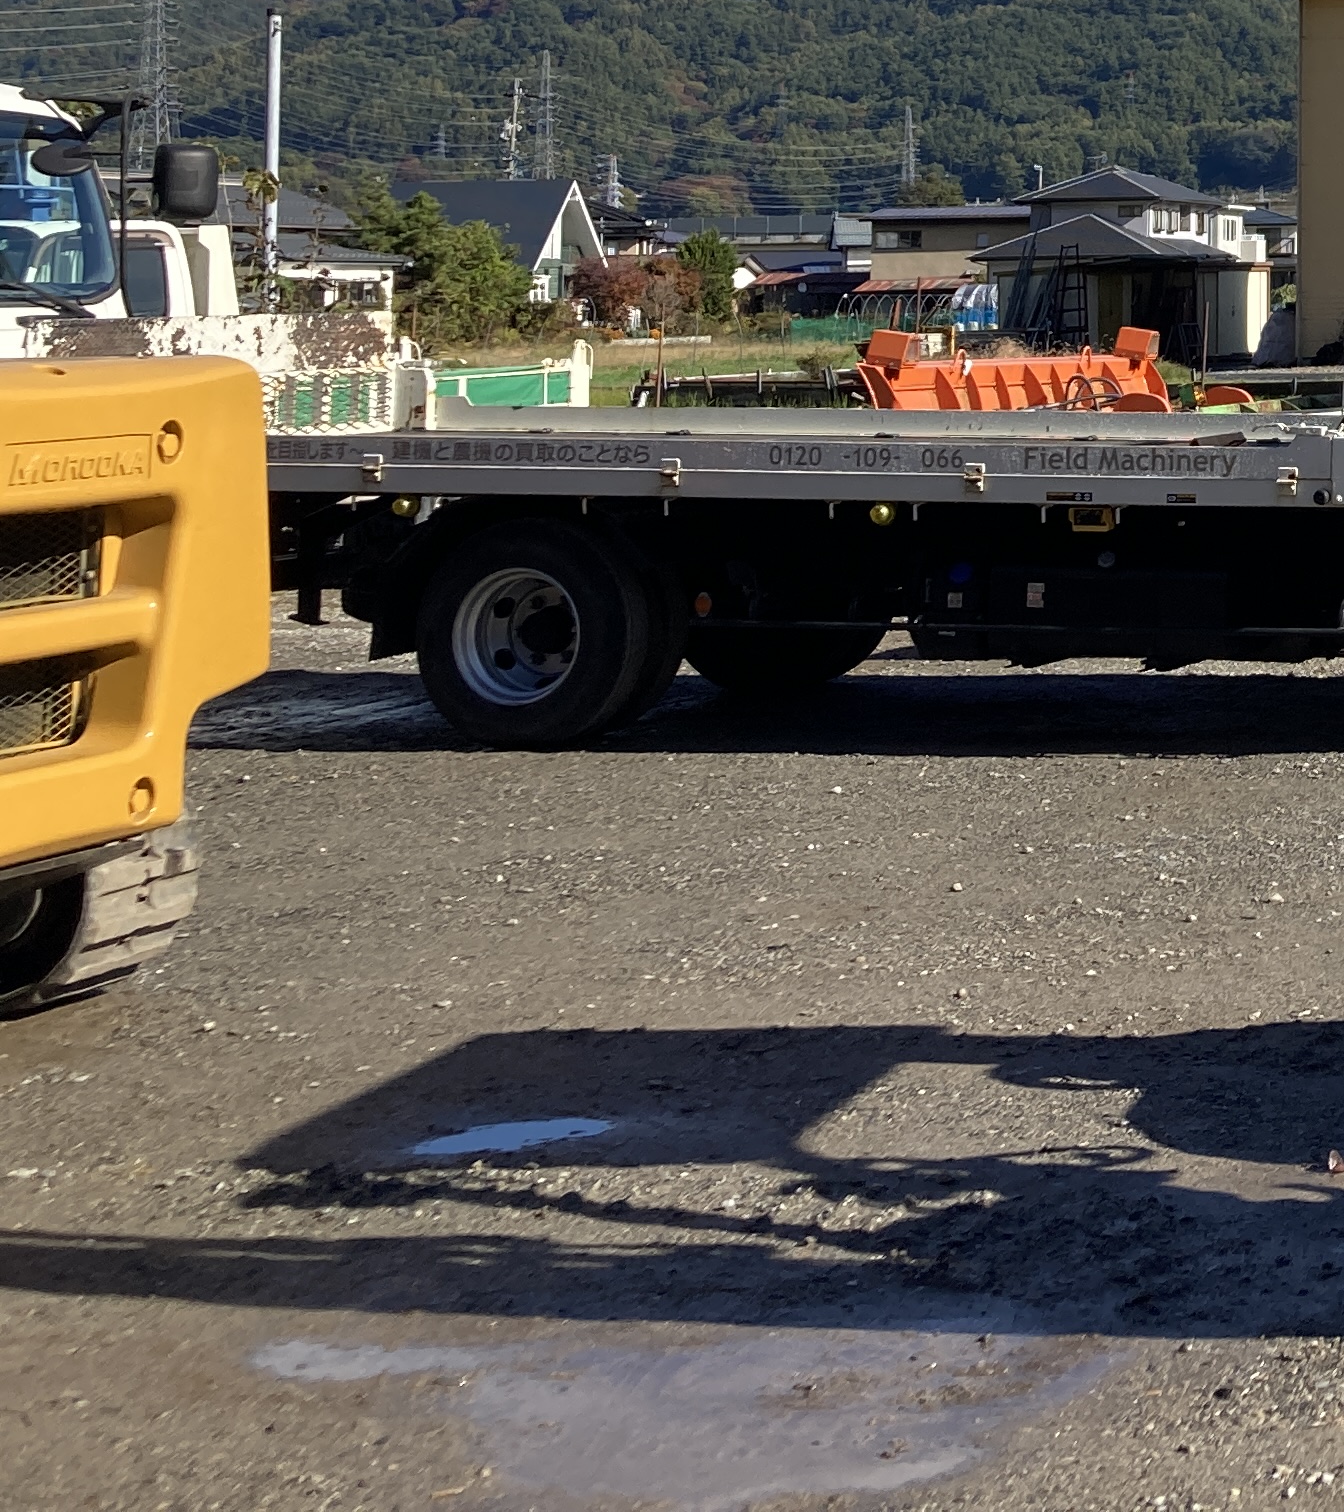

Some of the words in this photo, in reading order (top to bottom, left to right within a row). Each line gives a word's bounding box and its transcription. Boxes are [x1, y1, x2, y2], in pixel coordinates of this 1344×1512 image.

[769, 445, 822, 466] 0120
[921, 448, 963, 468] 066
[1024, 447, 1088, 471] Field
[1098, 448, 1236, 477] Machinery
